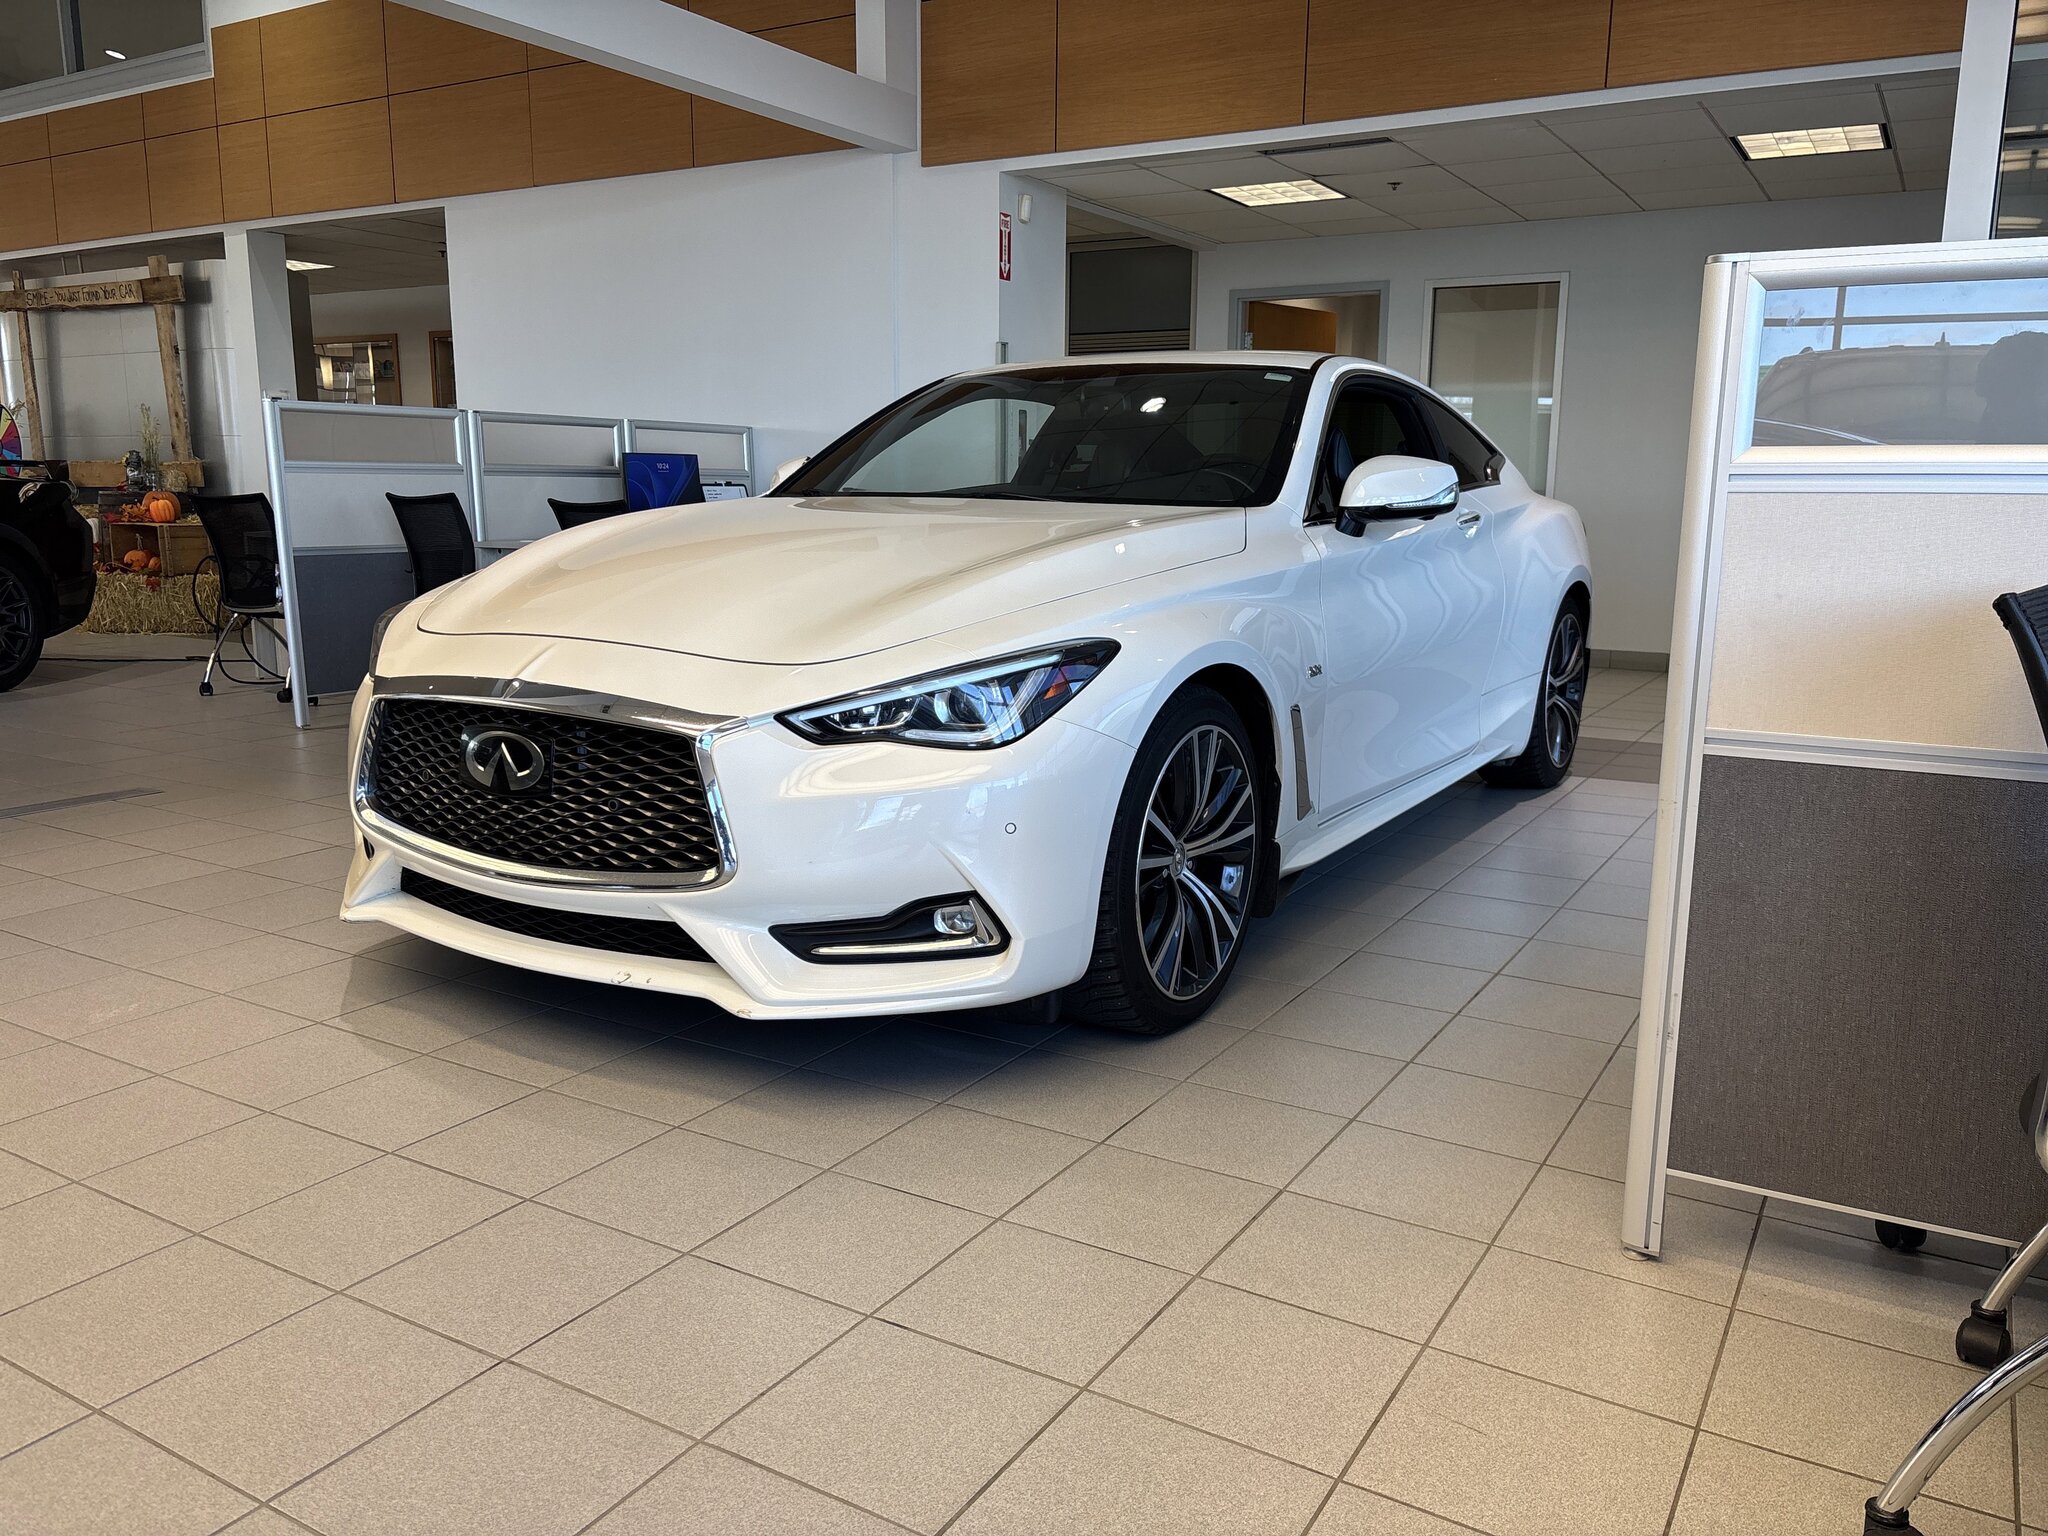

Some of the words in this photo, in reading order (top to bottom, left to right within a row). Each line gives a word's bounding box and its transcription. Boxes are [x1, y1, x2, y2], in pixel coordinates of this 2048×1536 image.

[1001, 219, 1009, 229] FIRE
[26, 291, 49, 306] SMILE
[119, 283, 136, 300] CAR
[656, 462, 669, 470] 10:24
